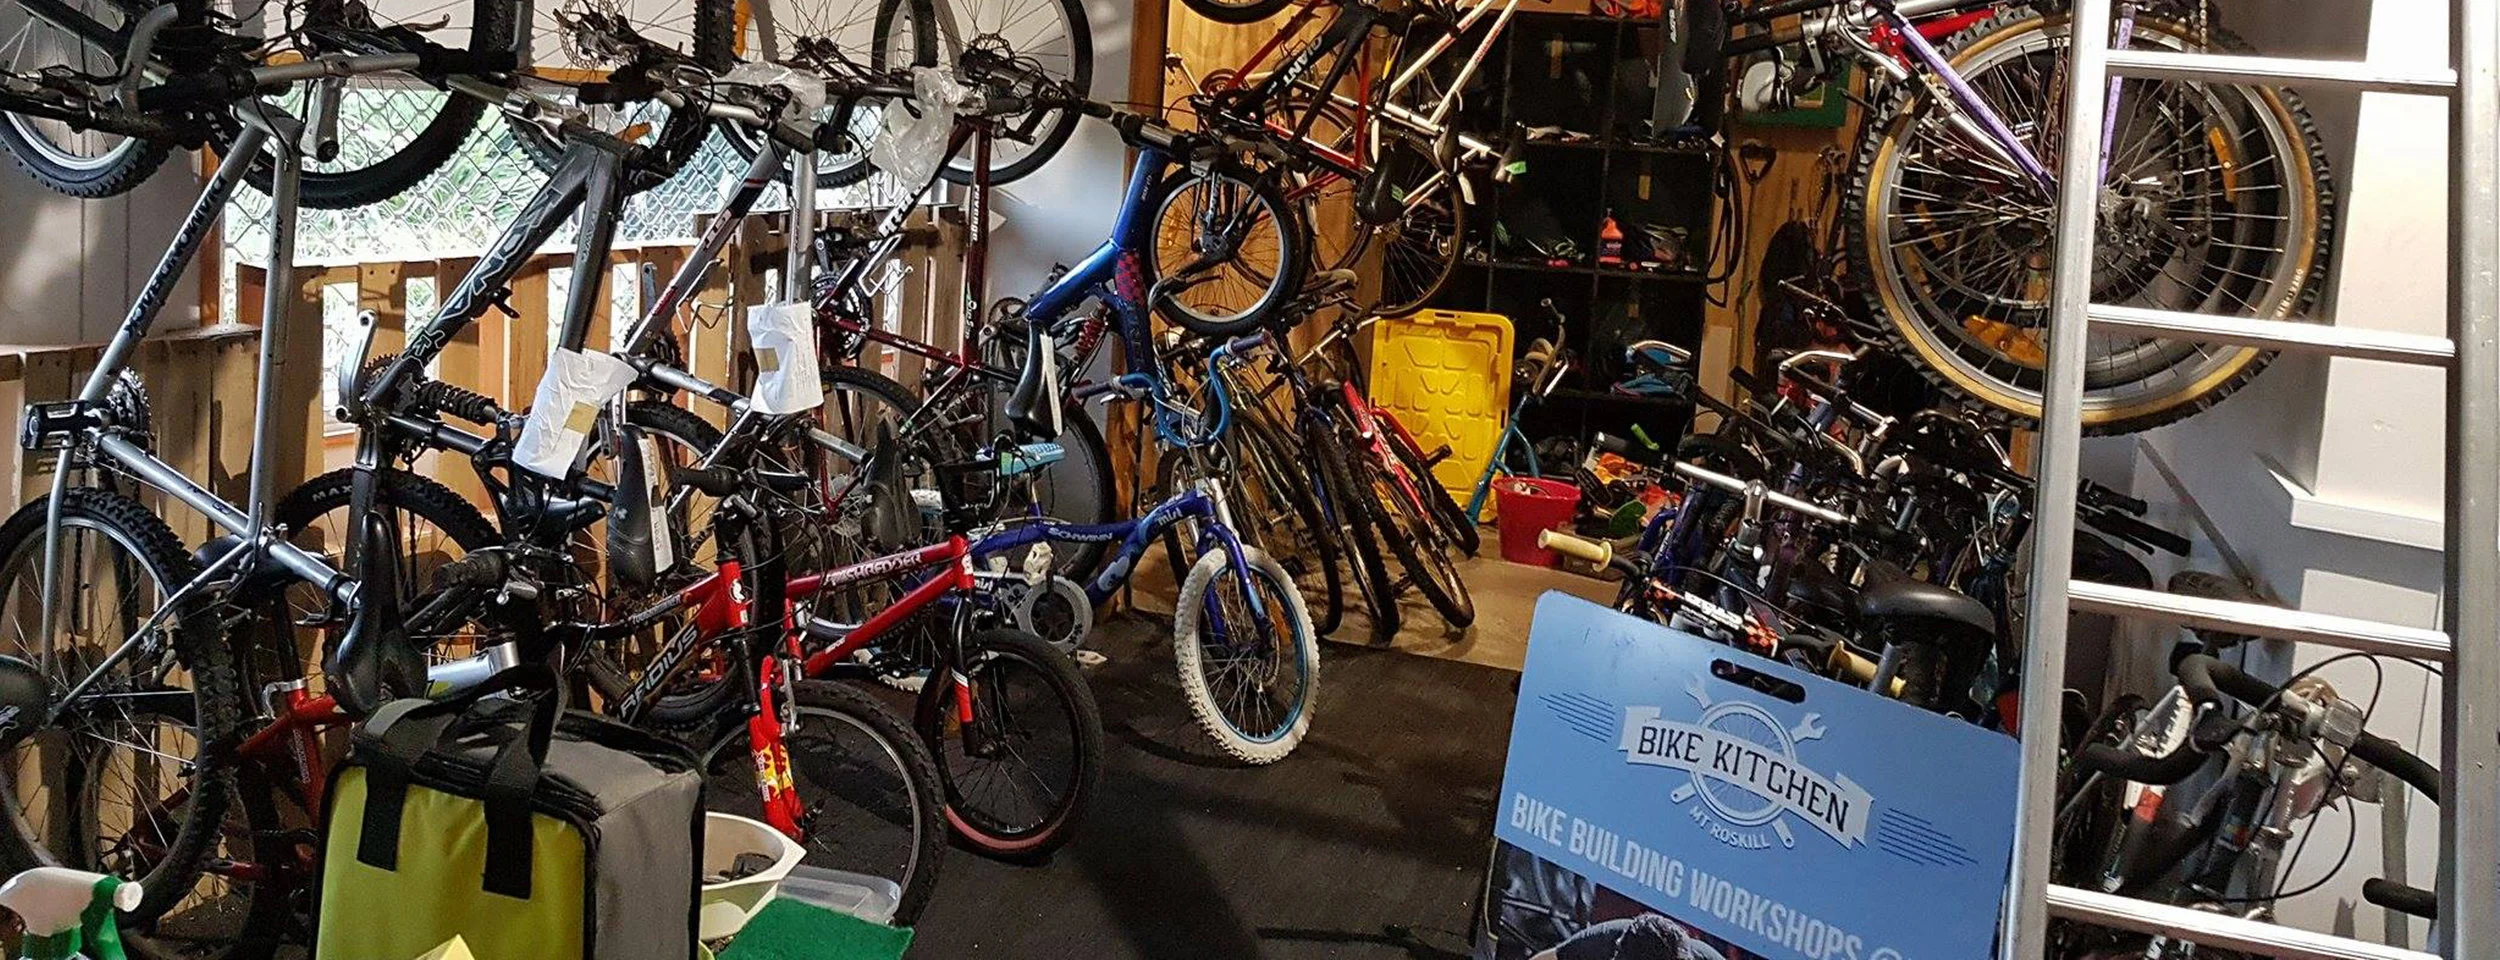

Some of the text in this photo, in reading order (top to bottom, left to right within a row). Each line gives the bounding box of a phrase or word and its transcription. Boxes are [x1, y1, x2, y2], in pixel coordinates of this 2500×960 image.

[1283, 35, 1322, 87] GIANT
[439, 186, 563, 319] KONA
[580, 209, 598, 263] DAWG
[705, 209, 732, 249] GT
[123, 174, 227, 339] DIAMONDBACK
[1048, 526, 1113, 542] SCHWINN
[846, 552, 923, 581] SHREDDER
[1637, 726, 1850, 833] BIKE KITCHEN
[1689, 805, 1771, 850] MT ROSKILL
[1511, 791, 1863, 960] BIKE BUILDING WORKSHOPS
